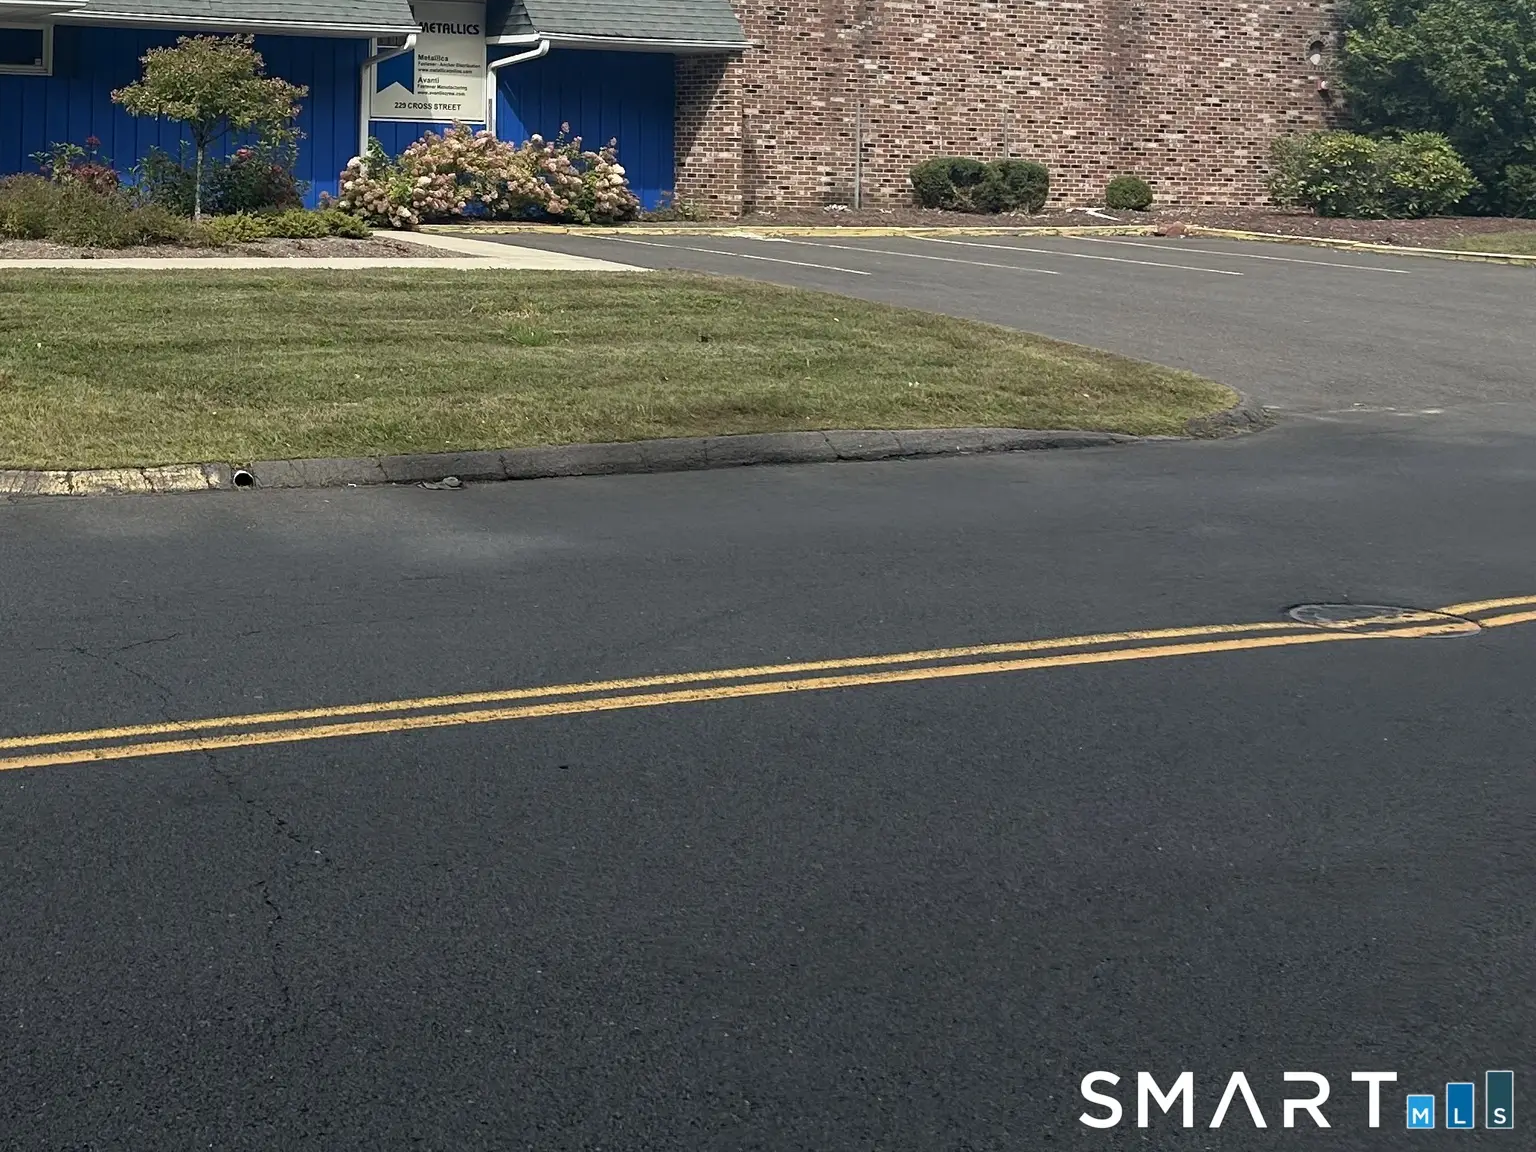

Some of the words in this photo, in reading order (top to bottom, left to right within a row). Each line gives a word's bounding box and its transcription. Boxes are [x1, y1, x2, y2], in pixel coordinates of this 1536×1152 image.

[418, 21, 480, 35] METALLICS
[407, 102, 433, 110] CROSS
[434, 103, 462, 111] STREET
